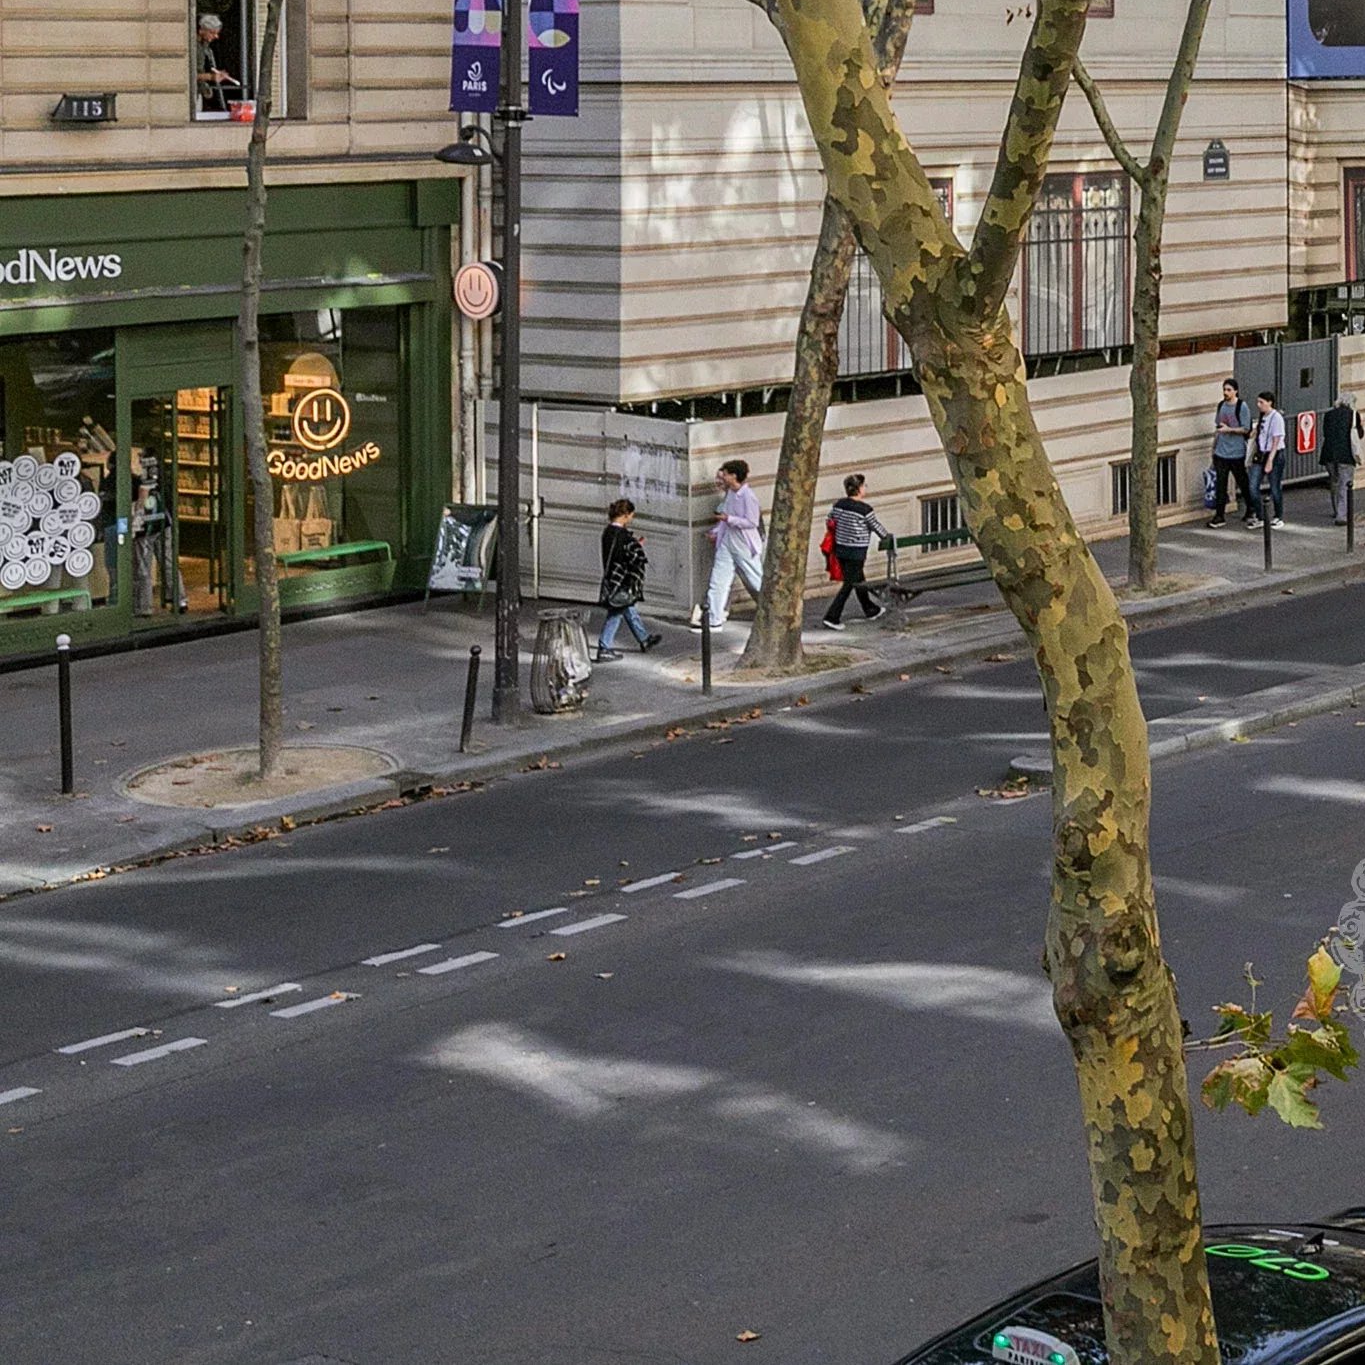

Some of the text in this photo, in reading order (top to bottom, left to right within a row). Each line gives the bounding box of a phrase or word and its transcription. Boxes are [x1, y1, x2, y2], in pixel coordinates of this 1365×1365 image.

[462, 80, 488, 92] PARIS
[72, 100, 102, 116] 115
[266, 442, 381, 480] GoodNews
[1012, 1335, 1046, 1358] TAXI
